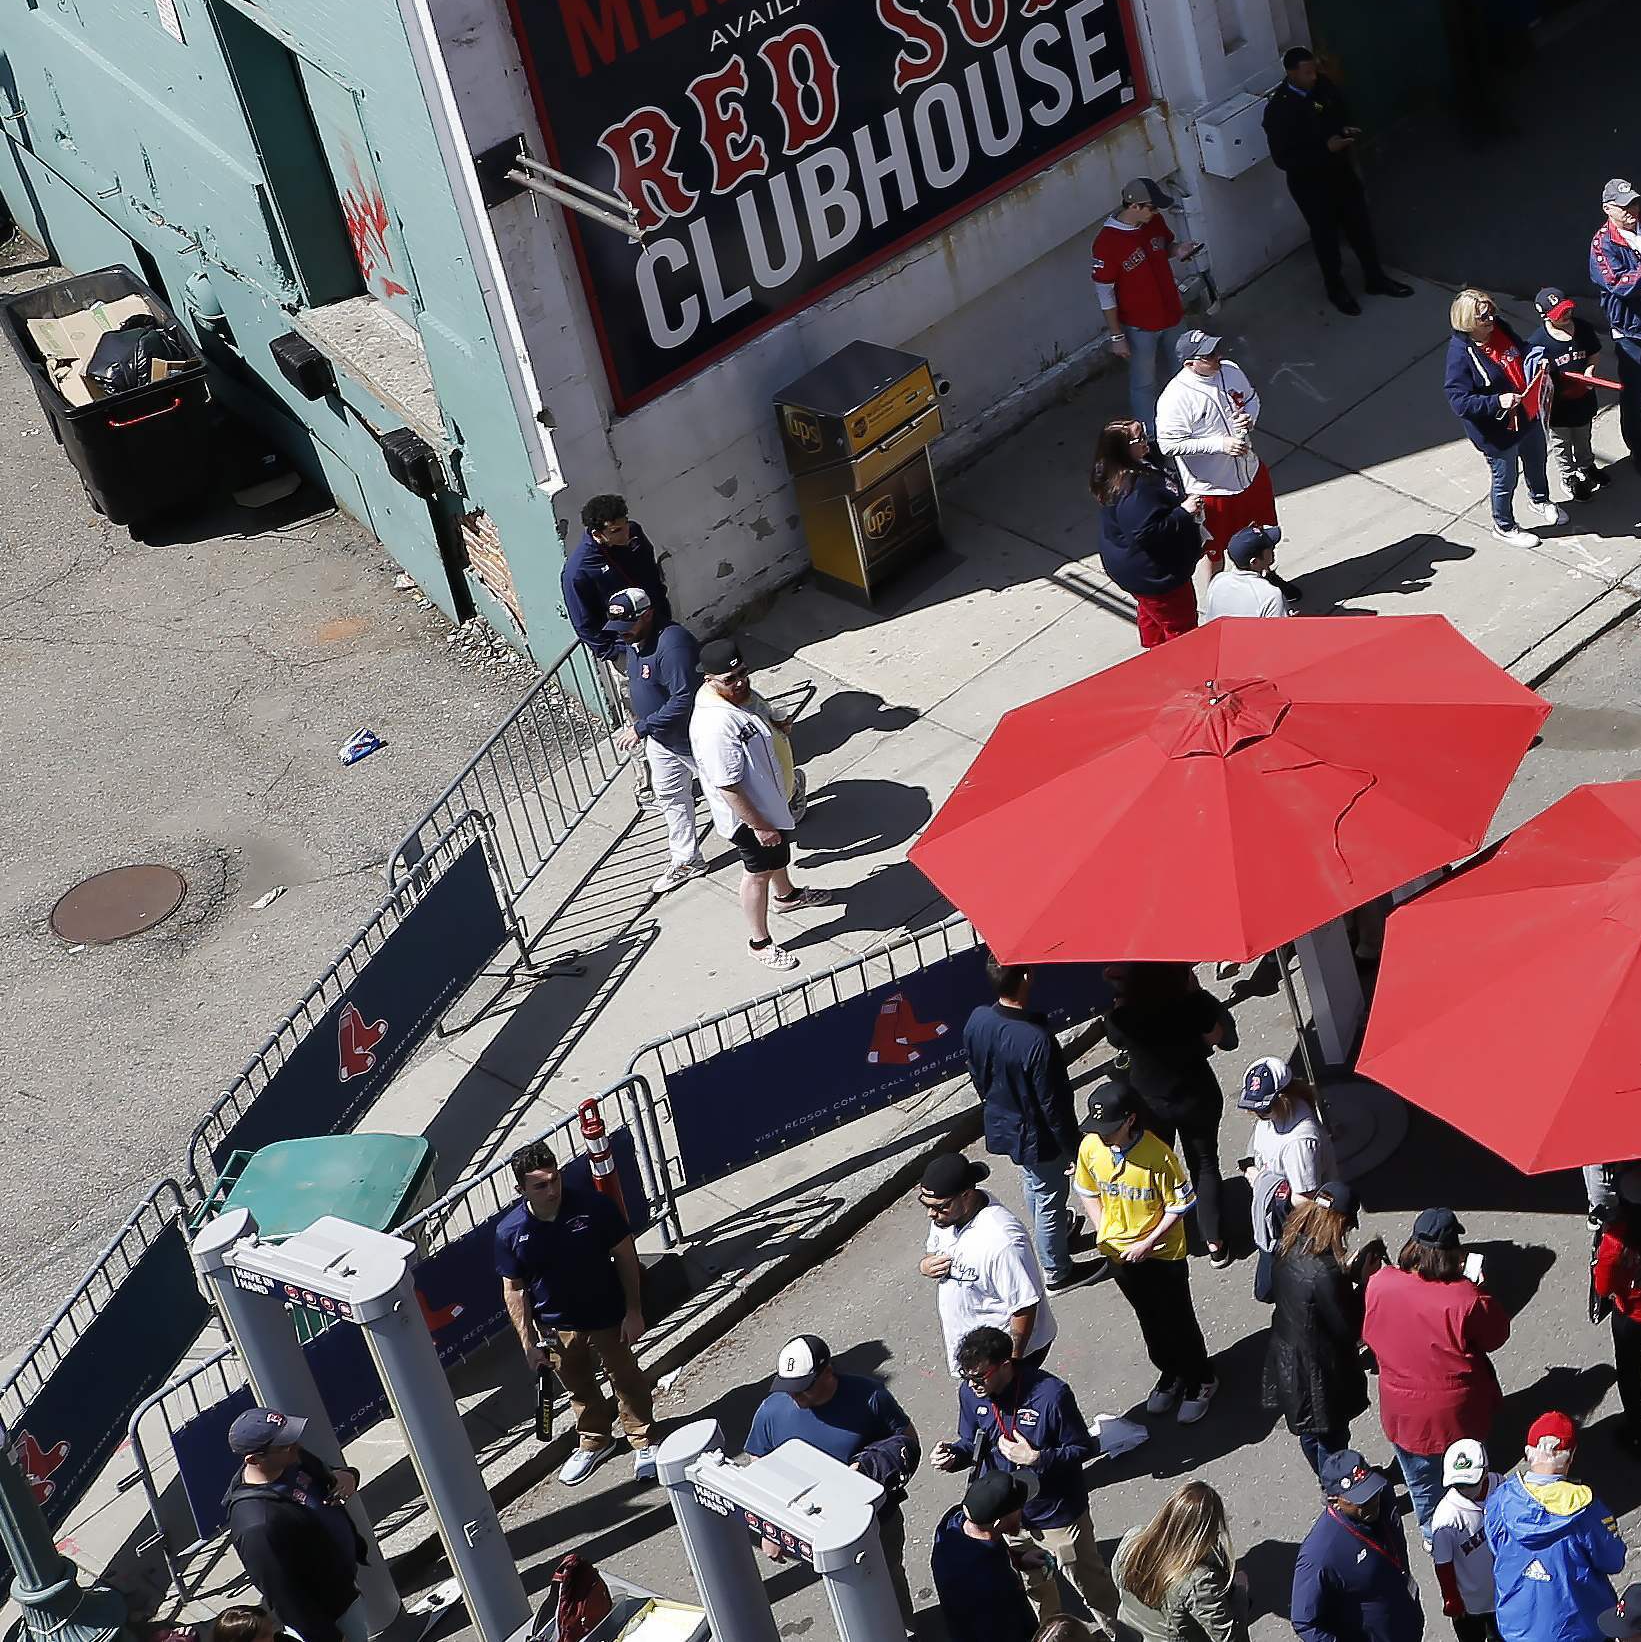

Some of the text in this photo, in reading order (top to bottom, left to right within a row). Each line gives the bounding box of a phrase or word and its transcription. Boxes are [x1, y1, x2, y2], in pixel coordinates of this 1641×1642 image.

[597, 24, 843, 232] RED
[790, 409, 816, 442] ups
[866, 507, 896, 536] ups
[755, 1128, 779, 1143] VISIT
[880, 1076, 906, 1095] CALL
